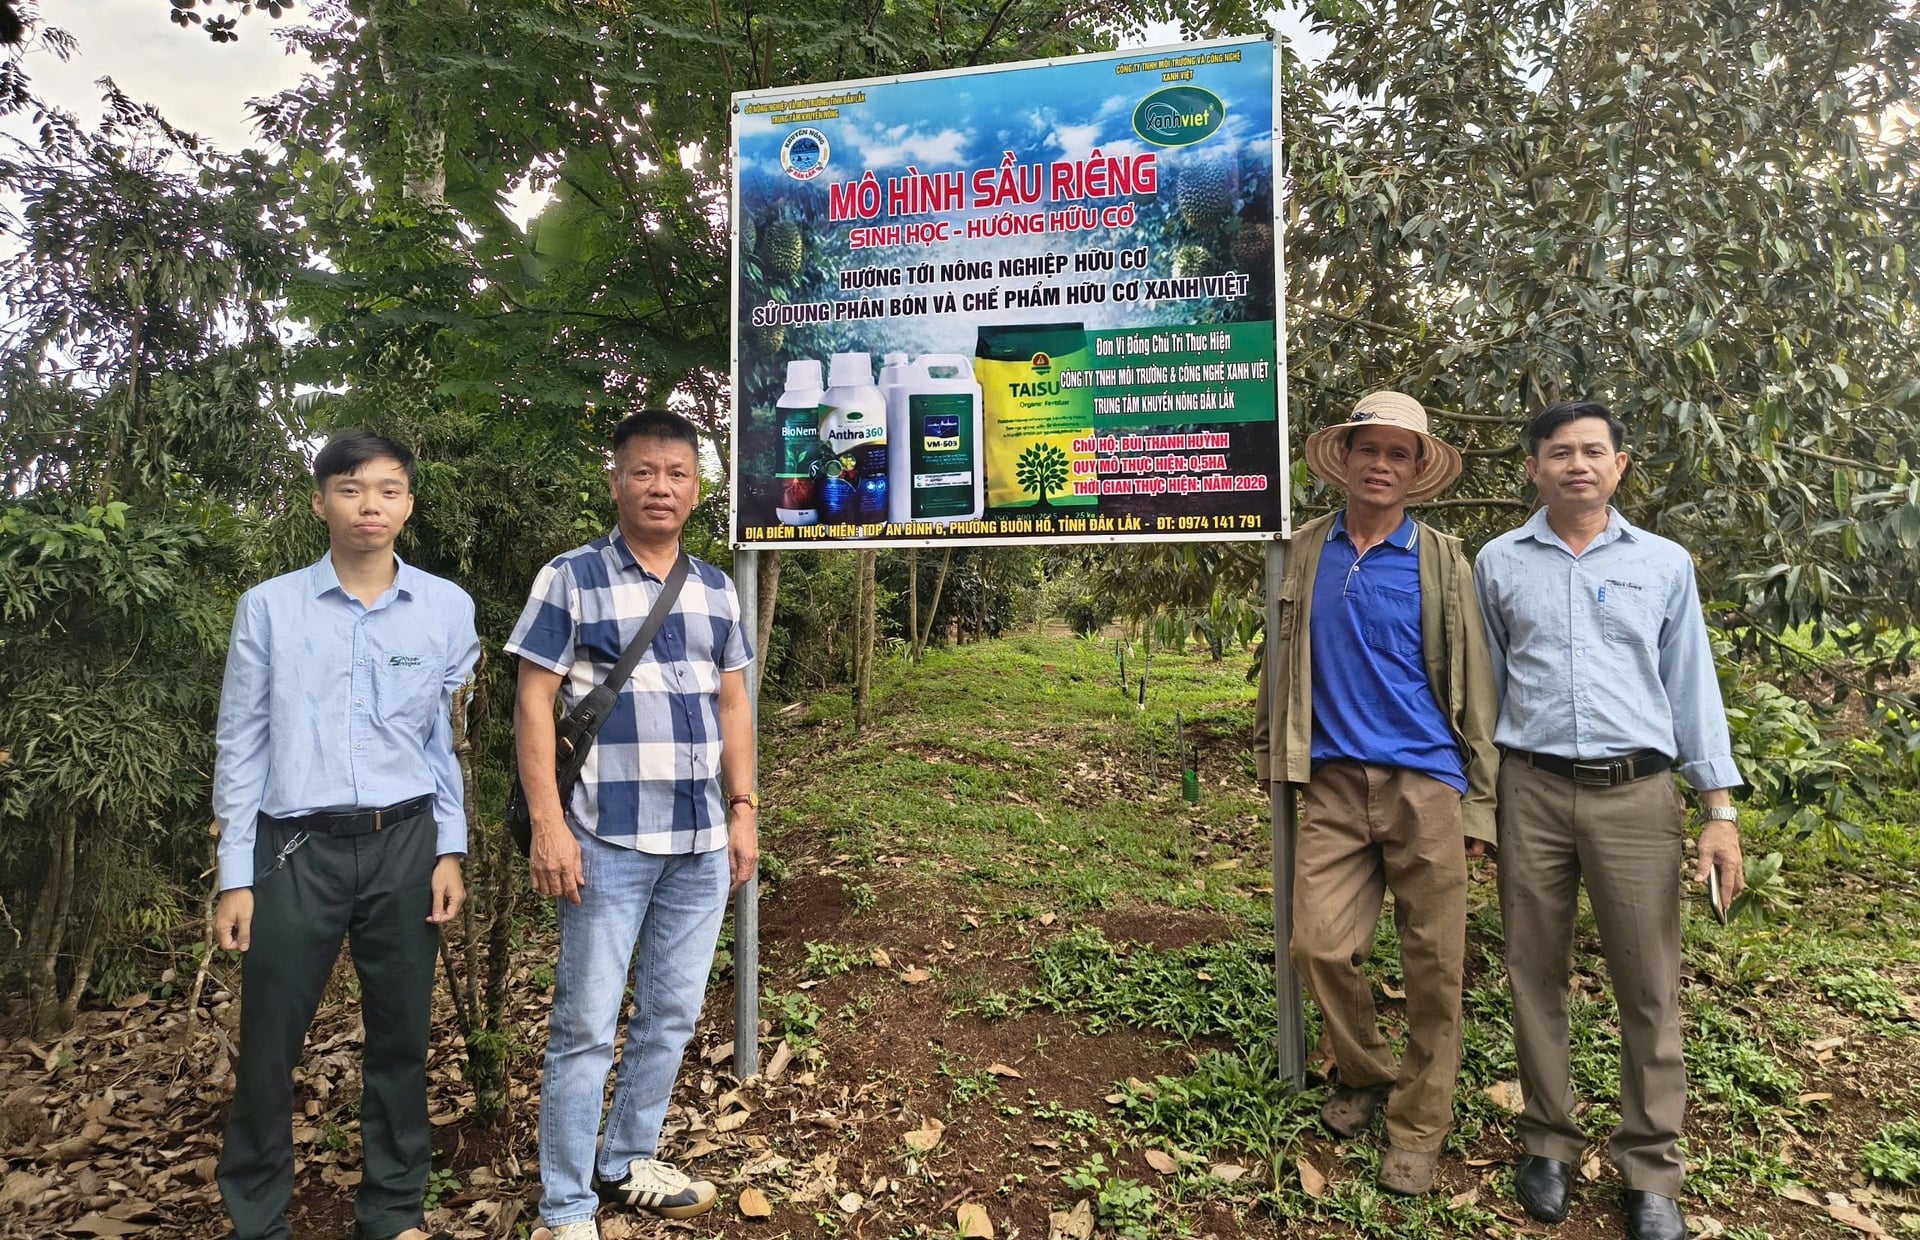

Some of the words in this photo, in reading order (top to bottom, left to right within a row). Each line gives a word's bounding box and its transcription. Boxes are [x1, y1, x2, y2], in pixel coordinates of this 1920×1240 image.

[1116, 63, 1132, 74] CÔNG
[1134, 64, 1140, 72] TY
[1142, 62, 1157, 71] TNHH
[1158, 58, 1171, 69] MÔI
[1172, 56, 1196, 68] TRƯỜNG
[1197, 54, 1206, 65] VÀ
[1206, 53, 1223, 64] CÔNG
[1224, 50, 1241, 63] NGHỆ
[1162, 72, 1179, 82] XANH
[1180, 69, 1194, 81] VIỆT
[829, 170, 881, 222] MÔ
[888, 166, 965, 216] HÌNH
[972, 151, 1042, 210] SẦU
[1051, 148, 1157, 201] RIÊNG
[850, 226, 901, 249] SINH
[905, 221, 950, 248] HỌC
[967, 212, 1045, 239] HƯỚNG
[1050, 204, 1097, 232] HỮU
[1102, 202, 1135, 228] CƠ
[839, 264, 901, 291] HƯỚNG
[906, 261, 935, 284] TỚI
[940, 258, 993, 283] NÔNG
[998, 251, 1069, 279] NGHIỆP
[1074, 248, 1114, 273] HỮU
[1120, 246, 1149, 269] CƠ
[752, 300, 780, 327] SỬ
[780, 302, 830, 328] DỤNG
[835, 296, 884, 321] PHÂN
[889, 293, 928, 317] BÓN
[932, 290, 957, 314] VÀ
[962, 284, 999, 312] CHẾ
[1004, 280, 1060, 310] PHẨM
[1066, 281, 1106, 305] HỮU
[1112, 278, 1139, 302] CƠ
[1144, 277, 1200, 301] XANH
[1204, 270, 1249, 302] VIỆT
[1096, 337, 1114, 356] Đơn
[1116, 336, 1125, 359] Vị
[1152, 332, 1169, 353] Chủ
[1172, 333, 1183, 352] Trì
[1186, 333, 1208, 355] Thực
[1210, 331, 1231, 354] Hiện
[1060, 367, 1082, 388] CÔNG
[1084, 370, 1094, 386] TY
[1095, 370, 1116, 386] TNHH
[1118, 365, 1134, 385] MÔI
[1136, 364, 1168, 384] TRƯỜNG
[1170, 366, 1176, 383] &
[1179, 362, 1200, 382] CÔNG
[1202, 360, 1225, 384] NGHỆ
[1227, 363, 1249, 380] XANH
[1251, 358, 1269, 382] VIỆT
[1009, 381, 1060, 398] TAISU
[1094, 398, 1120, 414] TRUNG
[1122, 394, 1140, 413] TÂM
[1142, 390, 1174, 412] KHUYẾN
[1176, 391, 1198, 410] NÔNG
[1200, 386, 1217, 410] ĐẮK
[1219, 386, 1235, 409] LẮK
[782, 426, 817, 436] BioNem
[1098, 434, 1120, 455] HỘ:
[1121, 434, 1143, 452] BÙI
[1144, 434, 1185, 451] THANH
[1187, 431, 1229, 450] HUỲNH
[1073, 459, 1097, 475] QUY
[1098, 456, 1120, 474] MÔ
[1121, 456, 1153, 475] THỰC
[1154, 454, 1188, 474] HIỆN:
[1189, 454, 1227, 472] 0,5HA
[1072, 478, 1100, 495] THỜI
[1102, 479, 1133, 495] GIAN
[1134, 477, 1166, 496] THỰC
[1168, 475, 1201, 495] HIỆN:
[1202, 474, 1233, 492] NĂM
[1235, 475, 1267, 491] 2026
[745, 526, 763, 542] ĐỊA
[766, 522, 794, 539] ĐIỂM
[798, 524, 826, 540] THỰC
[829, 522, 859, 540] HIỆN:
[862, 524, 882, 536] TDP
[886, 523, 902, 536] AN
[905, 520, 932, 535] BÌNH
[936, 521, 947, 536] 6,
[950, 518, 997, 534] PHƯỜNG
[1001, 518, 1034, 533] BUÔN
[1058, 515, 1088, 532] TỈNH
[1089, 514, 1114, 531] ĐẮK
[1118, 513, 1142, 531] LẮK
[1156, 516, 1175, 530] ĐT:
[1178, 516, 1209, 530] 0974
[1212, 515, 1234, 529] 141
[1238, 515, 1262, 528] 791
